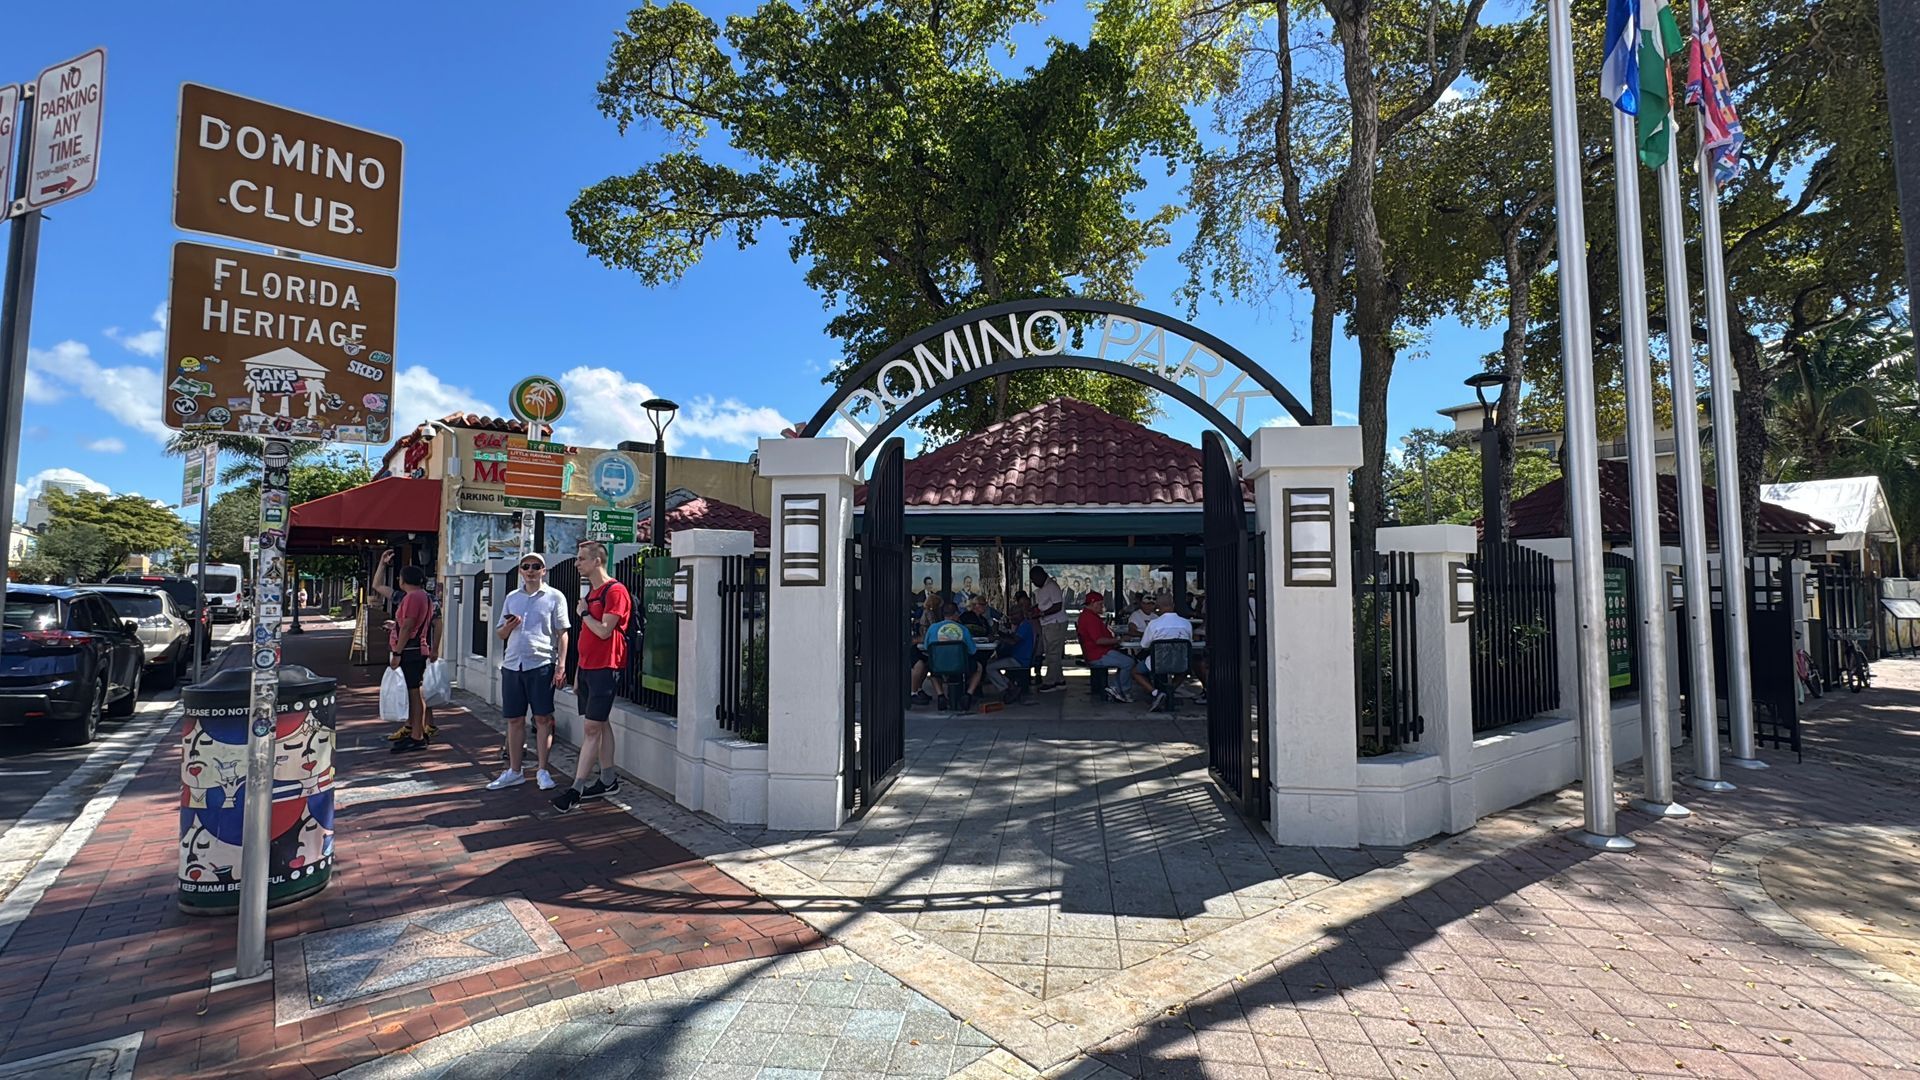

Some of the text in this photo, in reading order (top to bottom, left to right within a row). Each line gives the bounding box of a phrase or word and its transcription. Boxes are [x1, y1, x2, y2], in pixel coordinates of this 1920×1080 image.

[60, 67, 82, 93] NO
[40, 84, 98, 122] PARKING
[53, 112, 81, 140] ANY
[49, 135, 82, 164] TIME
[200, 115, 385, 190] DOMINO
[72, 154, 91, 170] ZONE
[229, 179, 355, 234] CLUB
[214, 258, 361, 311] FLORIDA
[203, 297, 367, 350] HERITAGE
[249, 368, 298, 381] CANS
[837, 309, 1273, 440] DOMINO PARK
[256, 380, 294, 392] MTA
[460, 492, 494, 502] ARKING
[592, 511, 600, 521] 8
[591, 521, 607, 532] 208
[644, 577, 661, 588] DOMINO
[647, 601, 663, 614] GÓMEZ
[186, 707, 249, 717] PLEASE DO NOT
[182, 884, 197, 892] KEEP
[198, 884, 225, 893] MIAMI
